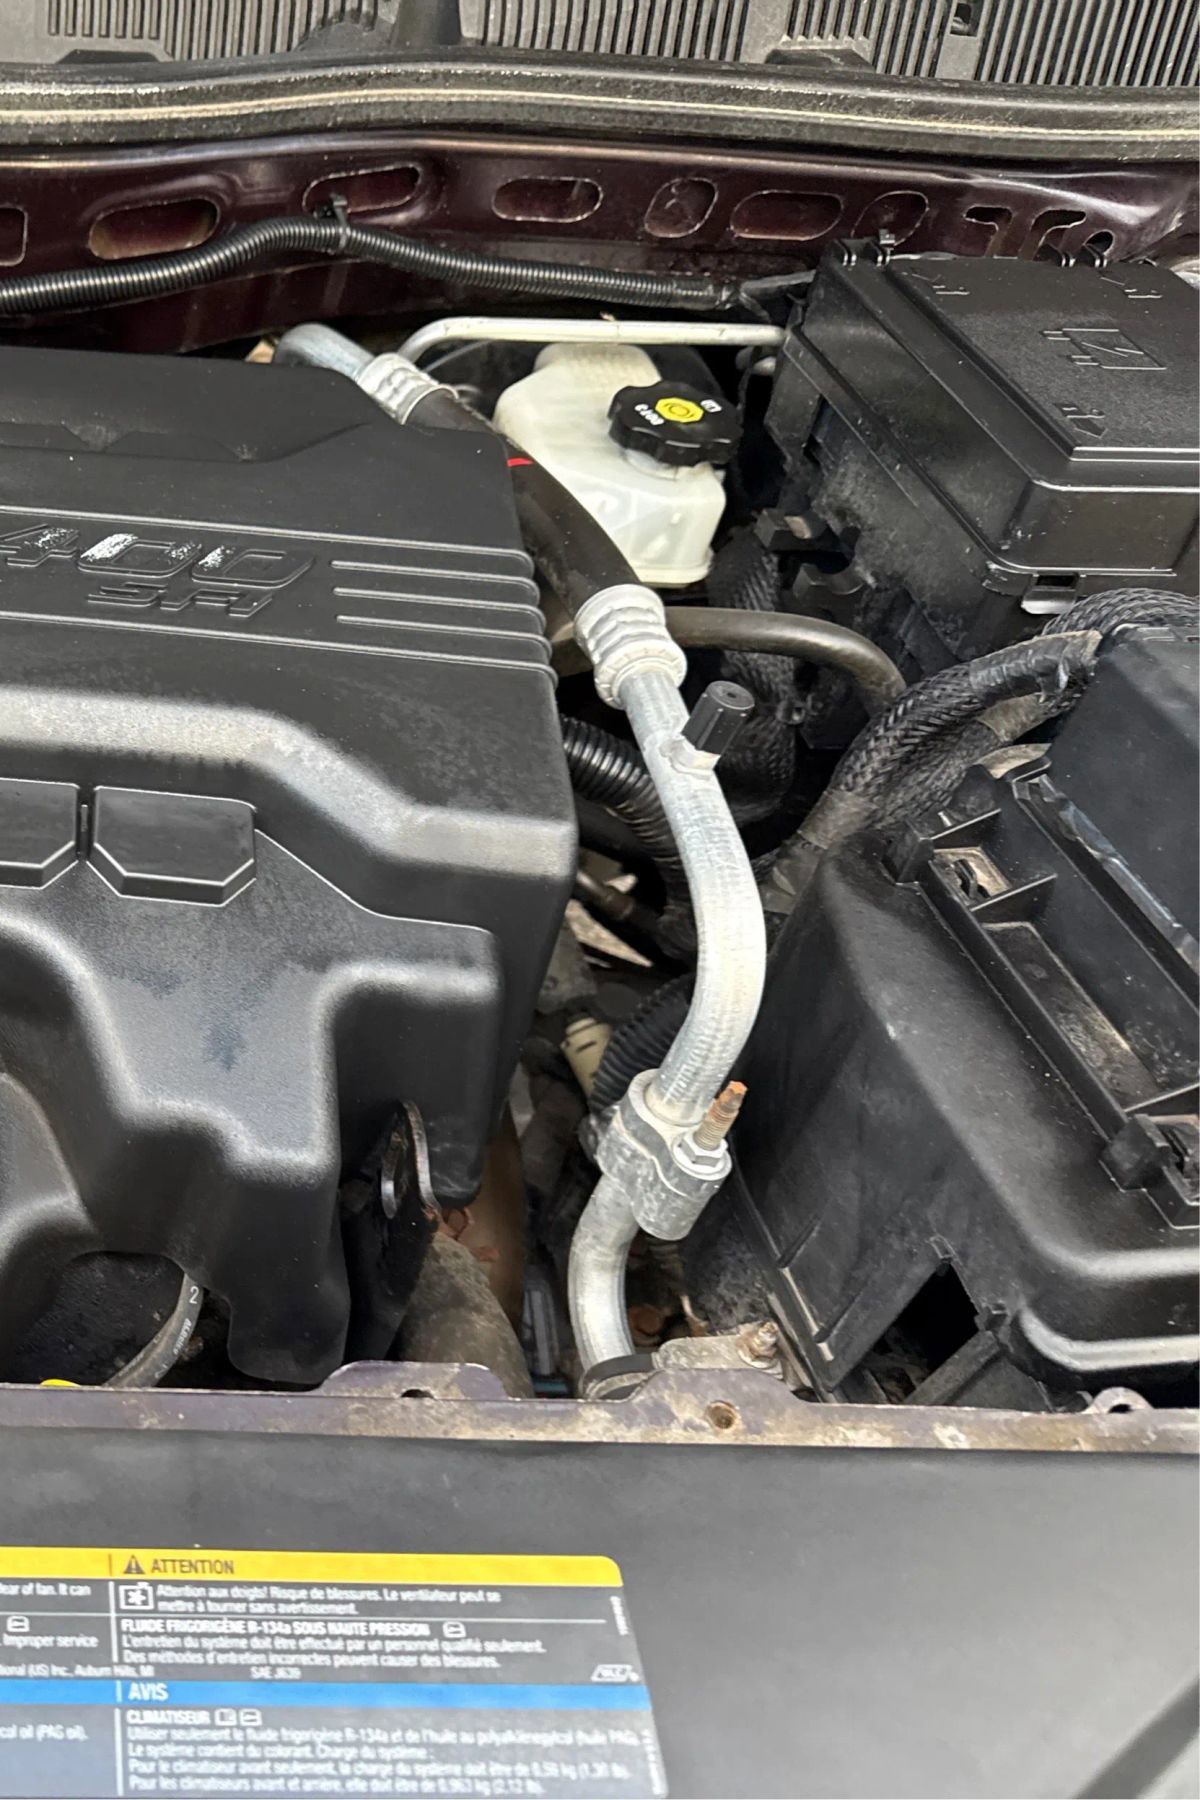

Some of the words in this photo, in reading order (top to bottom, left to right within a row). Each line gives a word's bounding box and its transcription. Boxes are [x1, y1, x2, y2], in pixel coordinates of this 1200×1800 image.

[189, 1285, 200, 1304] 2
[151, 1559, 234, 1574] ATTENTION
[21, 1582, 34, 1595] of
[58, 1583, 67, 1595] It
[69, 1585, 91, 1595] can
[308, 1587, 325, 1599] de
[382, 1588, 399, 1601] Le
[120, 1618, 165, 1632] FLUIDE
[246, 1620, 292, 1634] R-134a
[292, 1621, 327, 1635] SOUS
[326, 1622, 368, 1635] HAUTE
[368, 1622, 430, 1636] PRESSION
[3, 1633, 55, 1648] Improper
[56, 1634, 98, 1647] service
[128, 1682, 169, 1701] AVIS
[126, 1710, 211, 1725] CLIMATISEUR
